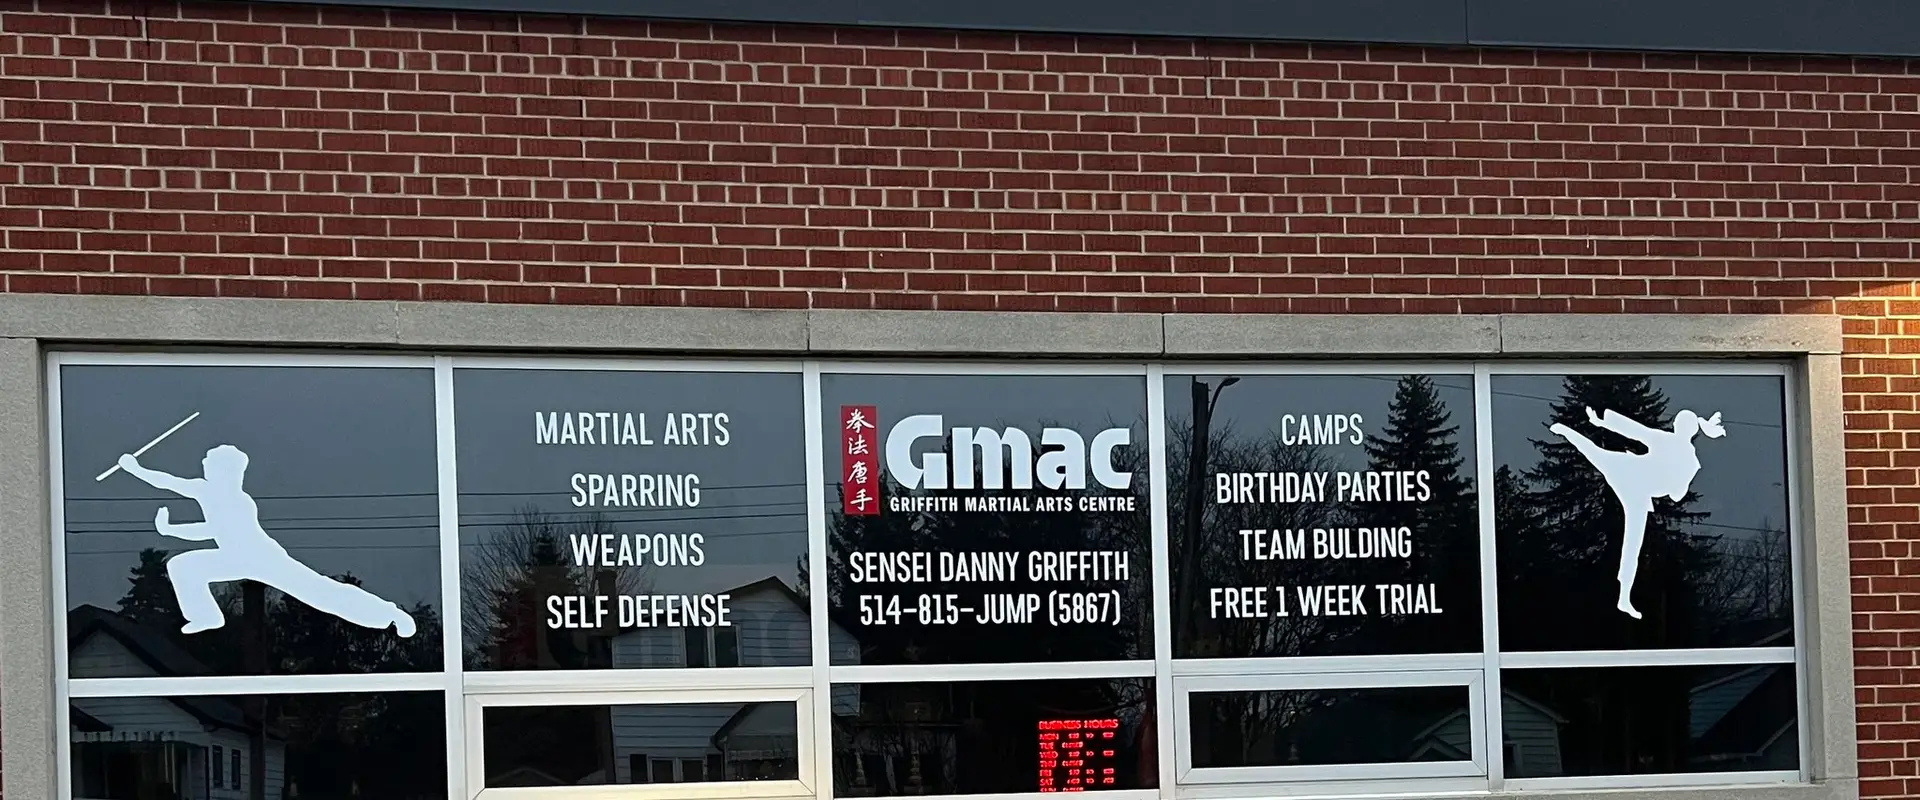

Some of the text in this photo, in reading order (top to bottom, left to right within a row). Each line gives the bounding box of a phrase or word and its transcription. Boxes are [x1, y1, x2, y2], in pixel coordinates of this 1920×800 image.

[535, 411, 730, 446] MARTIAL ARTS
[1281, 413, 1364, 446] CAMPS
[885, 414, 1133, 490] Gmac
[571, 473, 700, 507] SPARRING
[890, 496, 1135, 512] GRIFFITH MARTIAL ARTS CENTRE
[1216, 470, 1431, 504] BIRTHDAY PARTIES
[569, 533, 705, 567] WEAPONS
[1239, 526, 1412, 561] TEAM BULDING
[849, 550, 1129, 583] SENSEI DANNY GRIFFITH
[546, 593, 732, 629] SELF DEFENSE
[860, 589, 1121, 627] 514-815-JUMP (5867)
[1210, 583, 1443, 619] FREE 1 WEEK TRIAL
